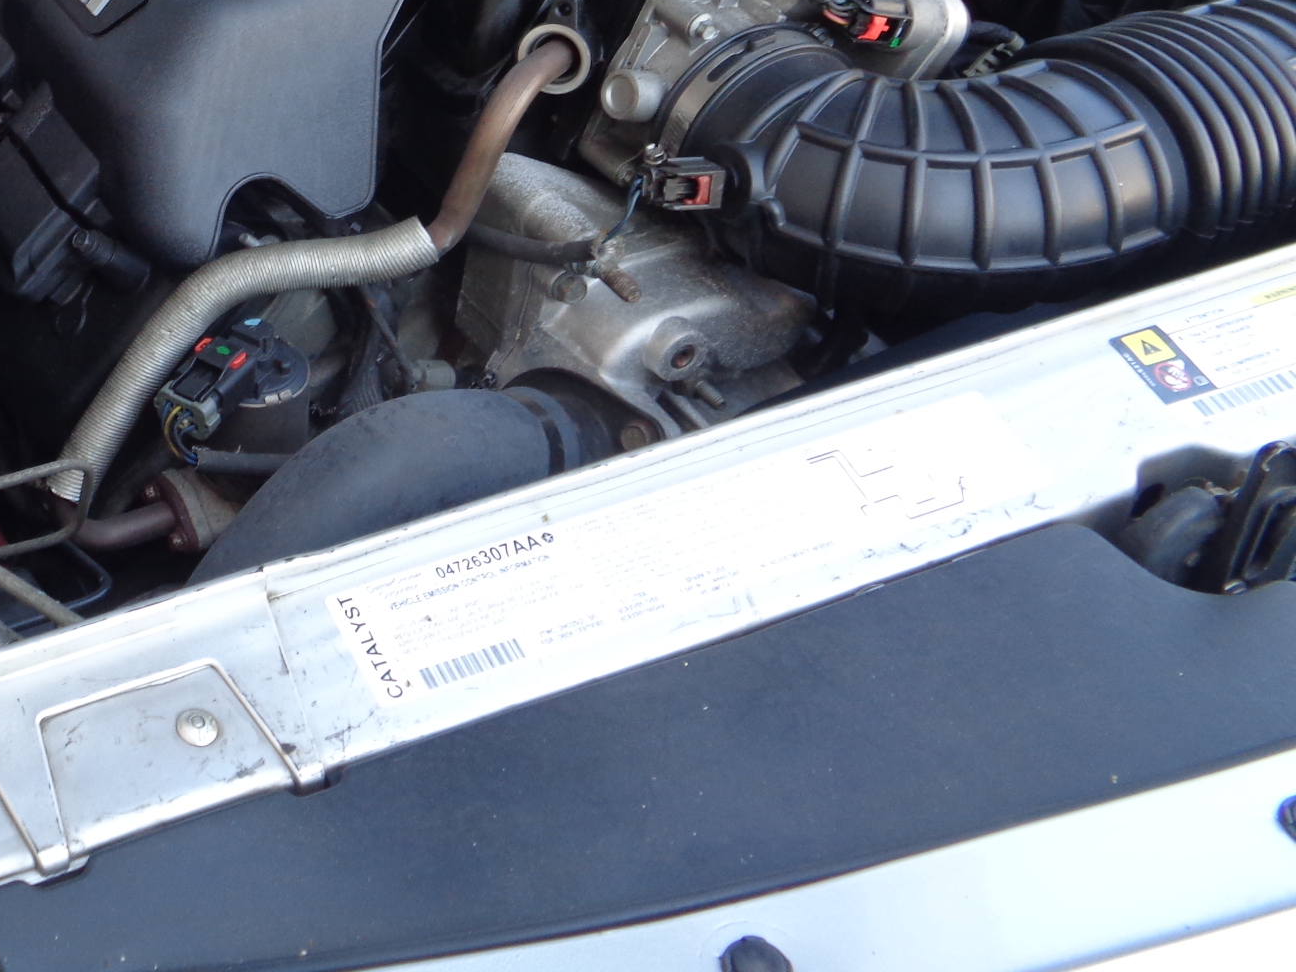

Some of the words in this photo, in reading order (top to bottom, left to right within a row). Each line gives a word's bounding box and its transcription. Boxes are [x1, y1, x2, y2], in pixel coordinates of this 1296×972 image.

[389, 594, 421, 610] VEHICLE
[423, 582, 459, 601] EMISSION
[460, 571, 497, 588] CONTROL
[499, 554, 551, 574] INFORMATION
[435, 535, 542, 579] 04726307AA
[336, 596, 404, 699] CATALYST
